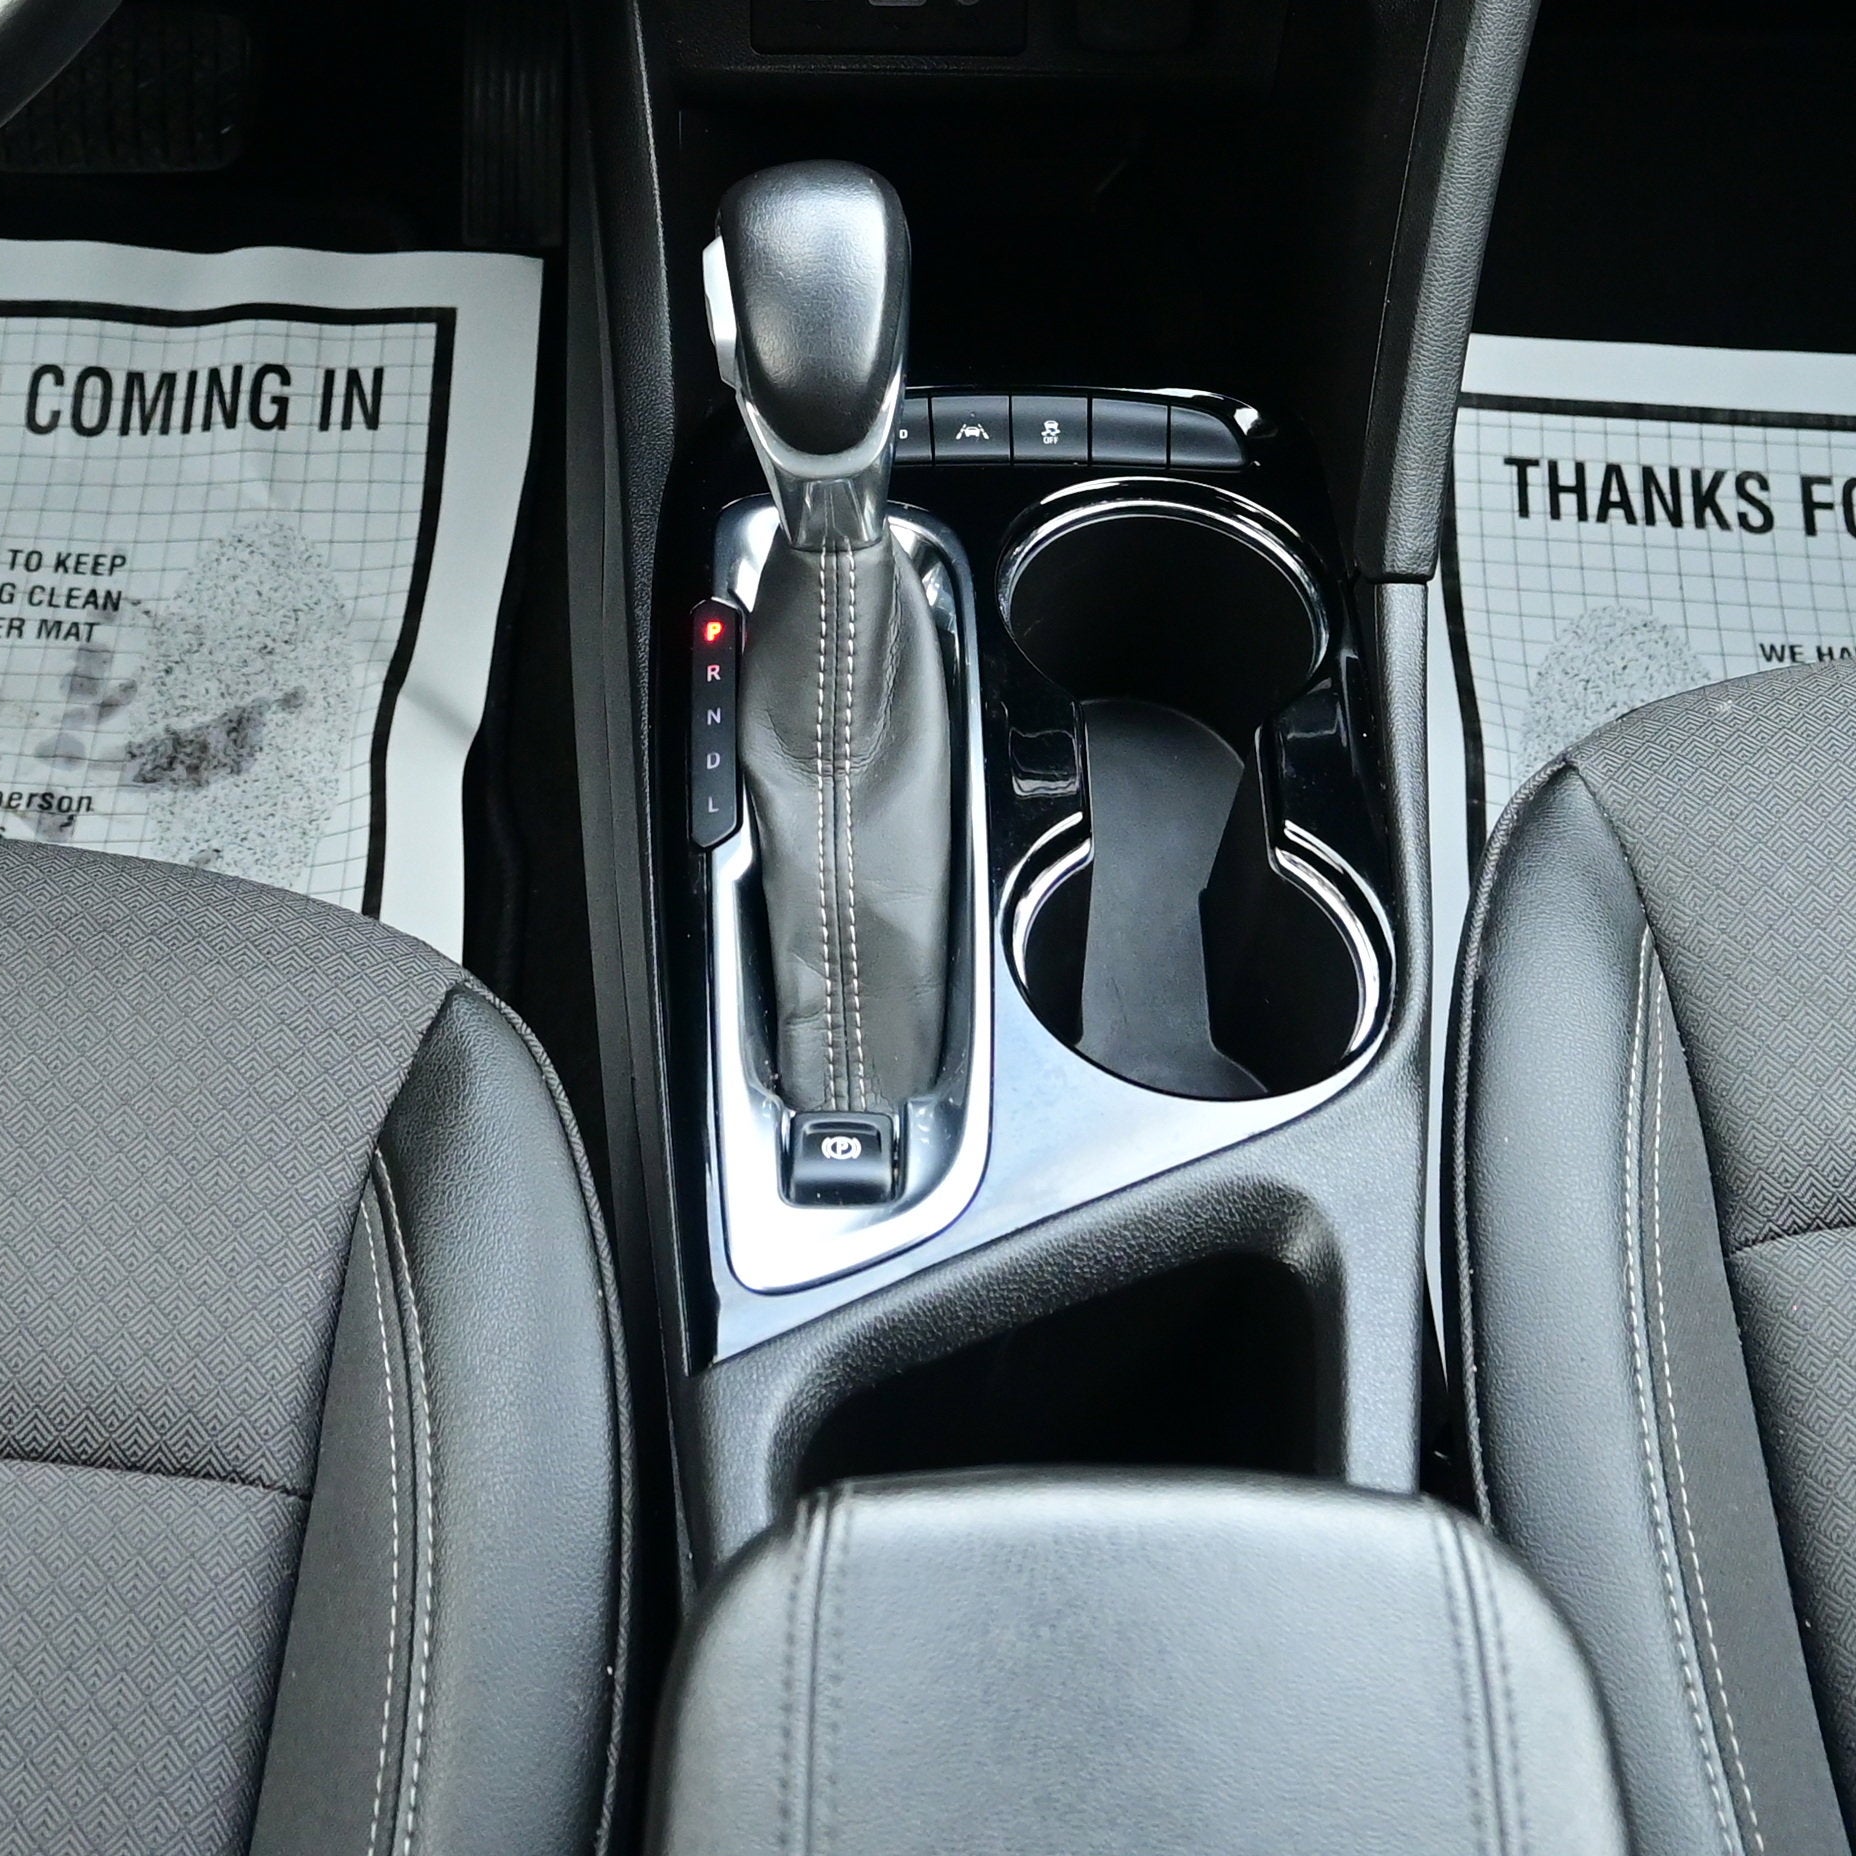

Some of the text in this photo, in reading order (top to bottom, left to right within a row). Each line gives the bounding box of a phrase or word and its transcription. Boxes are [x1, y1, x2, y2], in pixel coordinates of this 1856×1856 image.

[25, 364, 291, 436] COMING
[318, 366, 385, 431] IN
[1503, 455, 1775, 534] THANKS
[7, 550, 44, 573] TO
[53, 552, 127, 577] KEEP
[26, 584, 123, 612] CLEAN
[35, 619, 100, 643] MAT
[707, 622, 722, 640] P
[1759, 643, 1805, 663] WE
[708, 665, 720, 681] R
[708, 708, 720, 725] N
[707, 752, 720, 769] D
[708, 798, 719, 813] L
